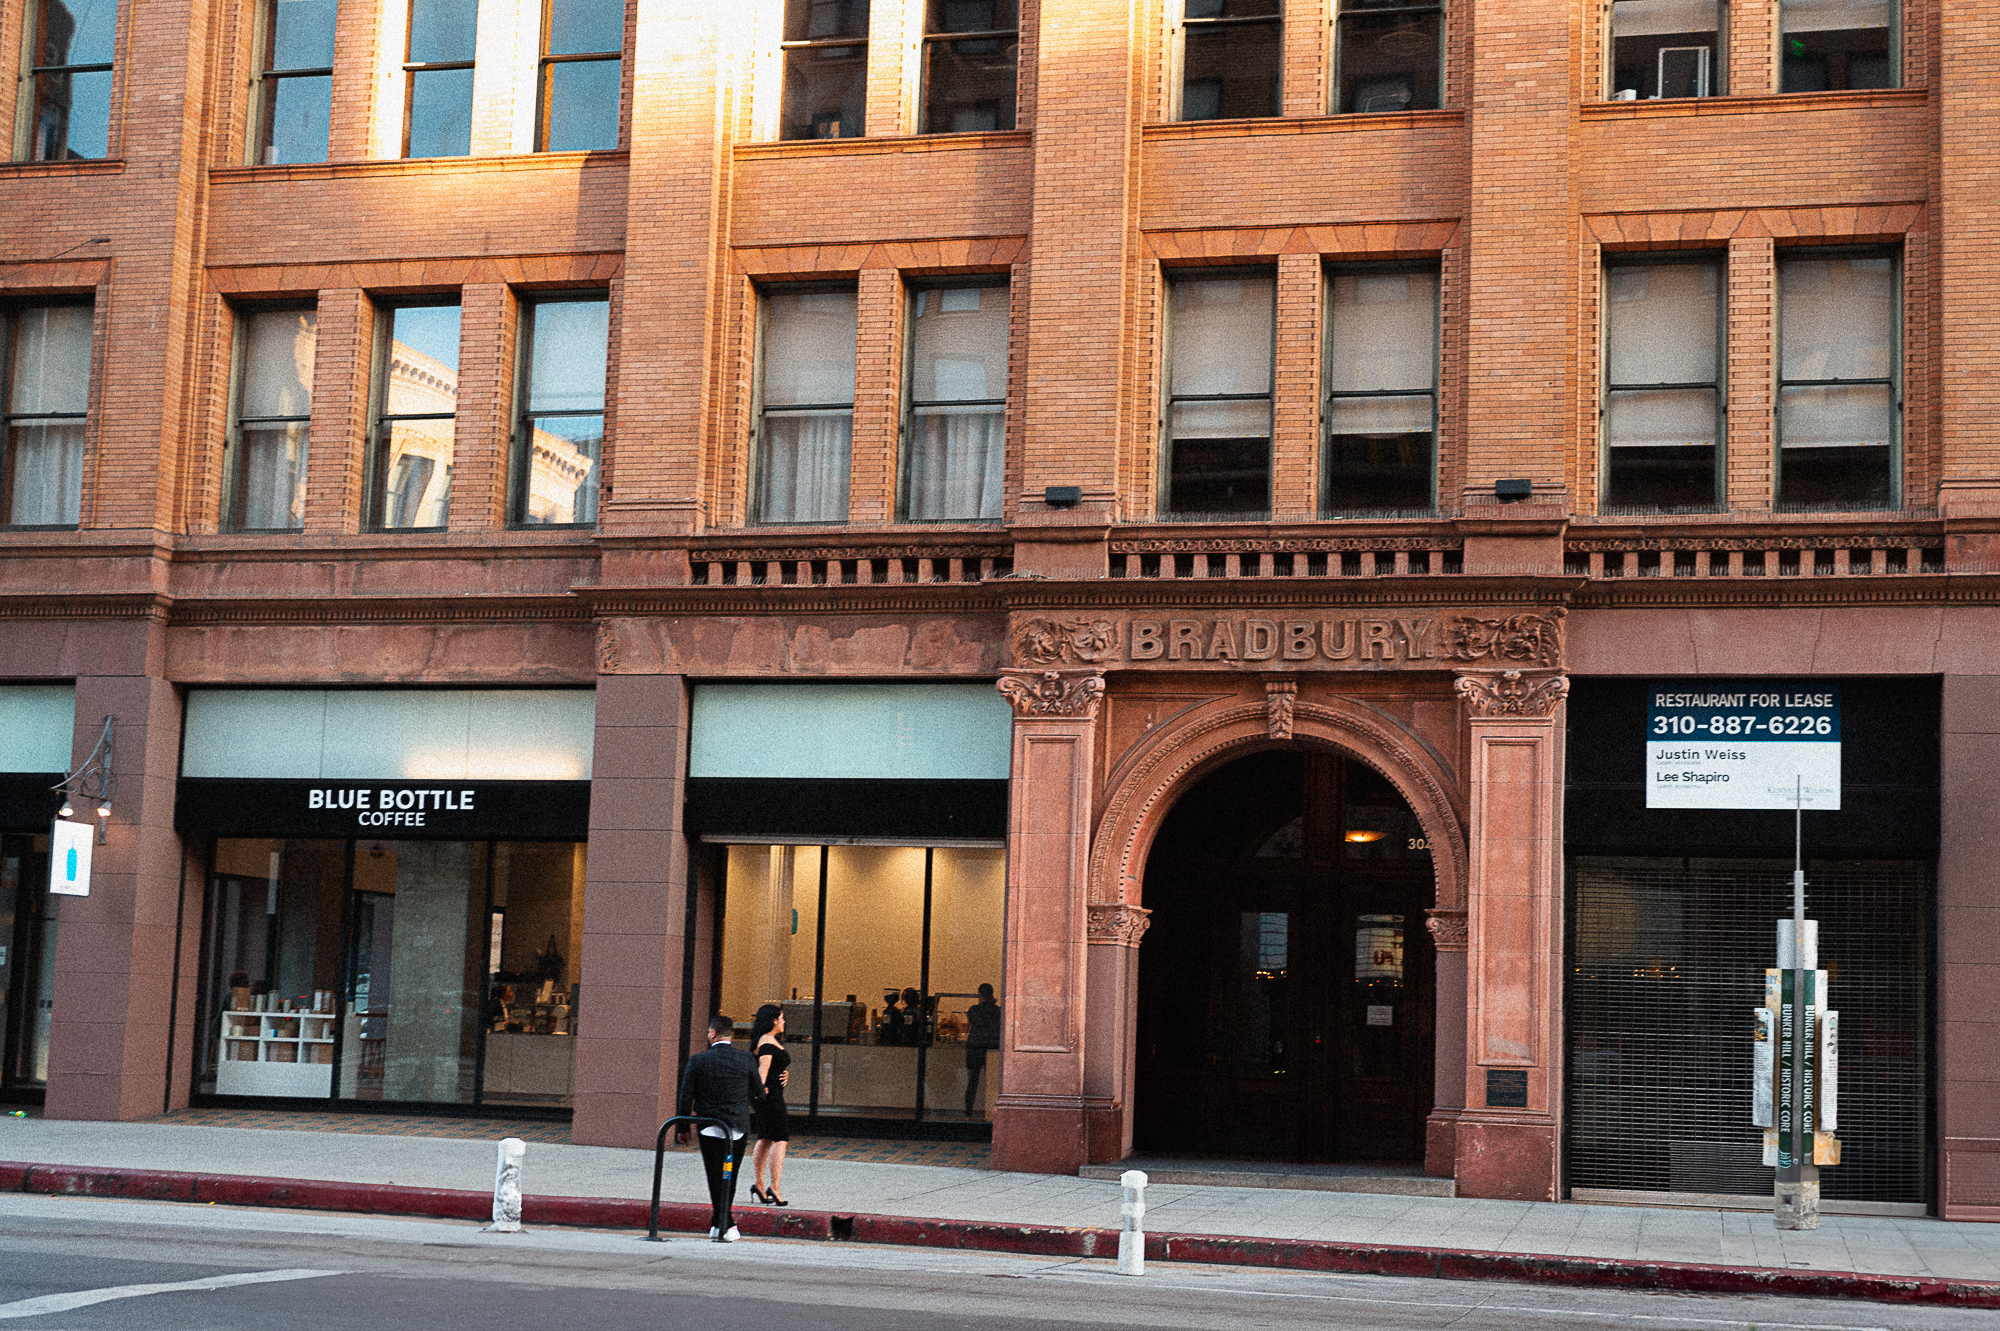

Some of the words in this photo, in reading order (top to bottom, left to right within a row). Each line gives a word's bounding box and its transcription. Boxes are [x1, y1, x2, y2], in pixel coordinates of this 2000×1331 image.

[1655, 693, 1746, 708] RESTAURANT
[1750, 693, 1780, 708] FOR
[1785, 693, 1833, 708] LEASE
[1653, 715, 1832, 735] 310-887-6226
[1656, 749, 1700, 760] Justin
[1704, 749, 1746, 760] Weiss
[1656, 772, 1679, 782] Lee
[1682, 771, 1730, 785] Shapiro
[308, 789, 371, 809] BLUE
[379, 789, 475, 810] BOTTLE
[358, 811, 426, 827] COFFEE
[1781, 1003, 1793, 1038] BUNKER
[1804, 1004, 1815, 1039] BUNKER
[1781, 1040, 1792, 1058] HILL
[1804, 1041, 1815, 1059] HILL
[1780, 1068, 1792, 1108] HISTORIC
[1803, 1069, 1814, 1109] HISTORIC
[1780, 1110, 1791, 1133] CORE
